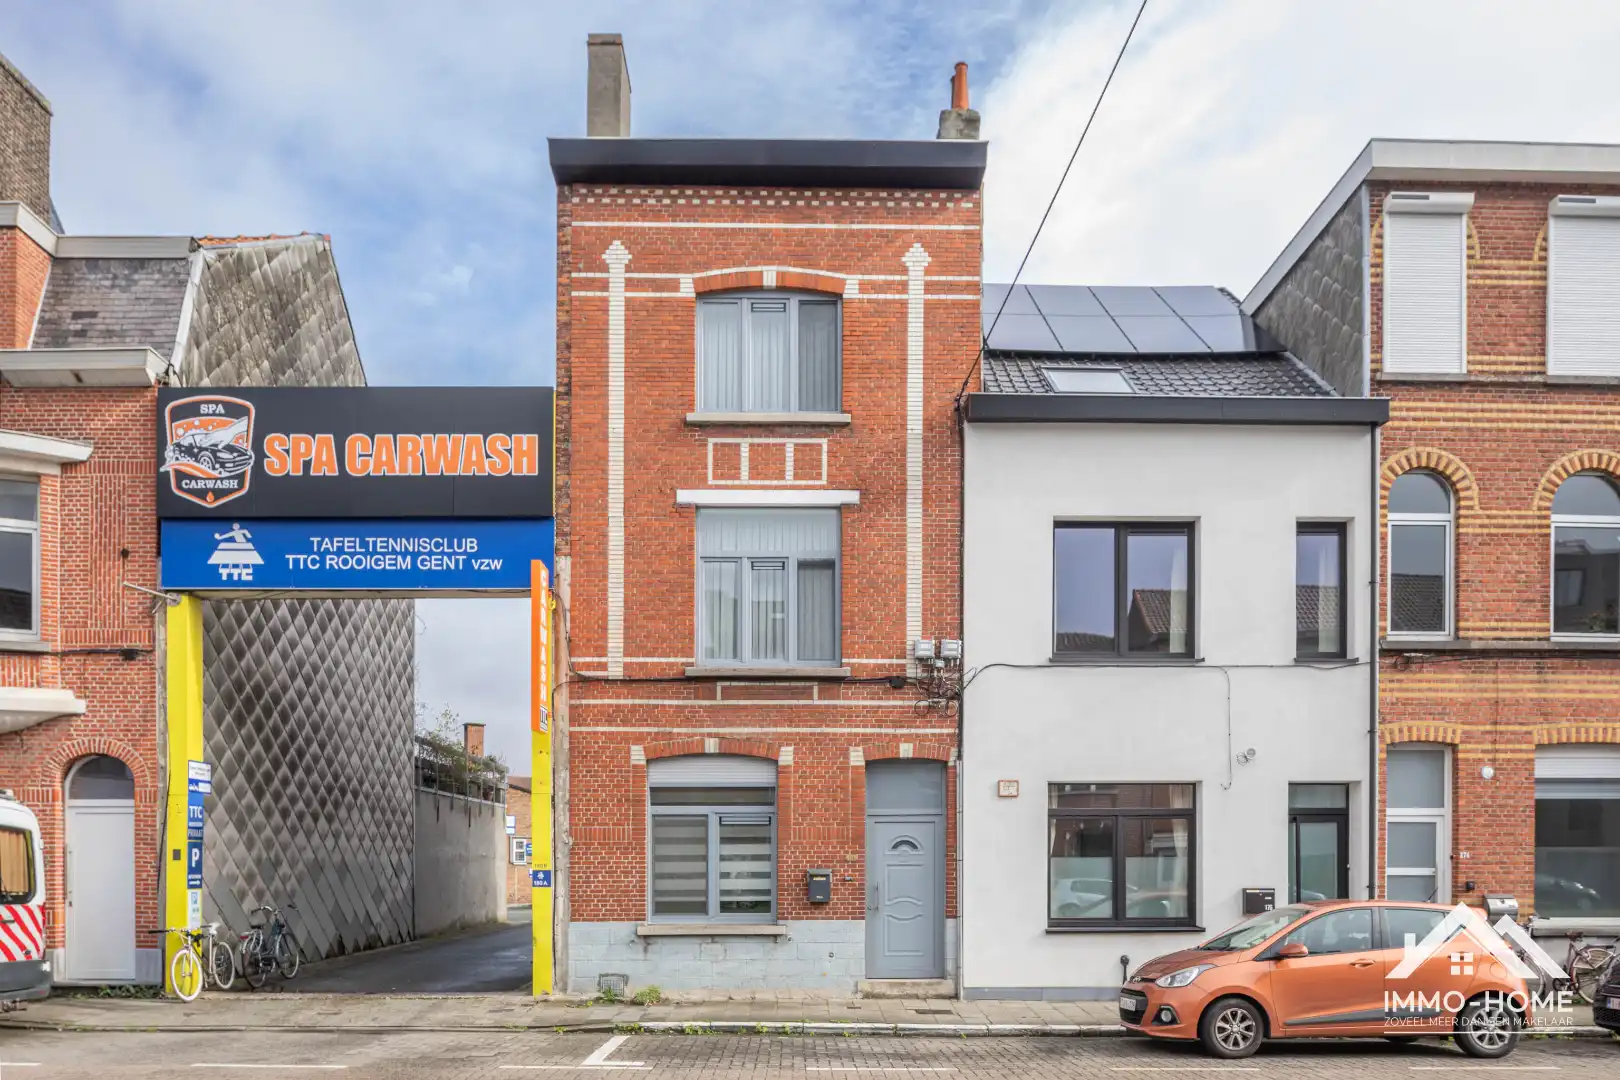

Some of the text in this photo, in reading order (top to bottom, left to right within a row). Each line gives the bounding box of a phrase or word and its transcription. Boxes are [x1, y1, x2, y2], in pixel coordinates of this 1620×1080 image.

[200, 403, 225, 414] SPA
[263, 433, 539, 477] SPA CARWASH
[181, 479, 239, 489] CARWASH
[310, 537, 478, 553] TAFELTENNISCLUB
[285, 554, 321, 570] TTC
[325, 554, 411, 570] ROOIGEM
[417, 554, 466, 570] GENT
[218, 567, 254, 581] TTC
[539, 568, 548, 703] CARWASH
[189, 805, 202, 818] TTC
[191, 847, 200, 868] P
